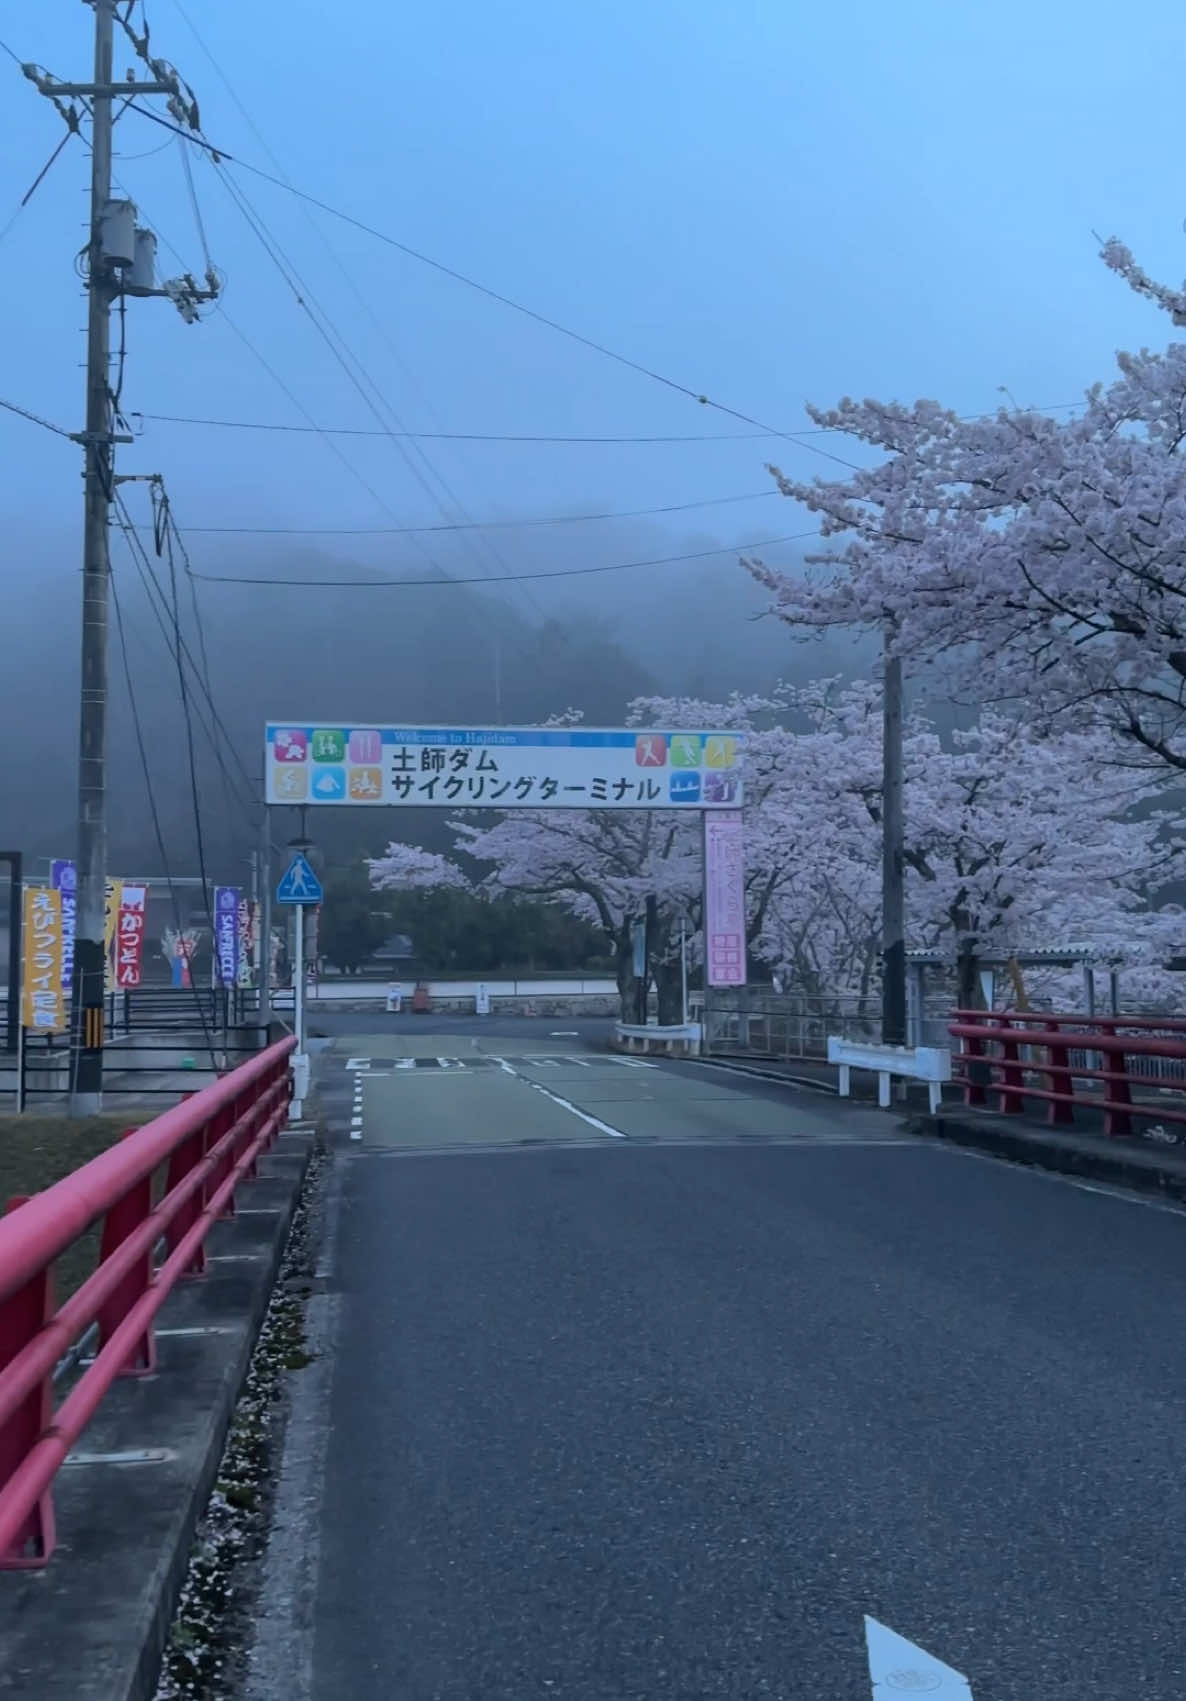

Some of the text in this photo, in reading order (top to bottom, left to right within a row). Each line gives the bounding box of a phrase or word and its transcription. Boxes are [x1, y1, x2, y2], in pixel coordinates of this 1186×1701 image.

[393, 731, 448, 744] Welcome
[449, 732, 463, 744] to
[391, 747, 499, 774] 土師ダム
[391, 775, 661, 802] サイクリングターミナル
[119, 912, 143, 985] かつどん
